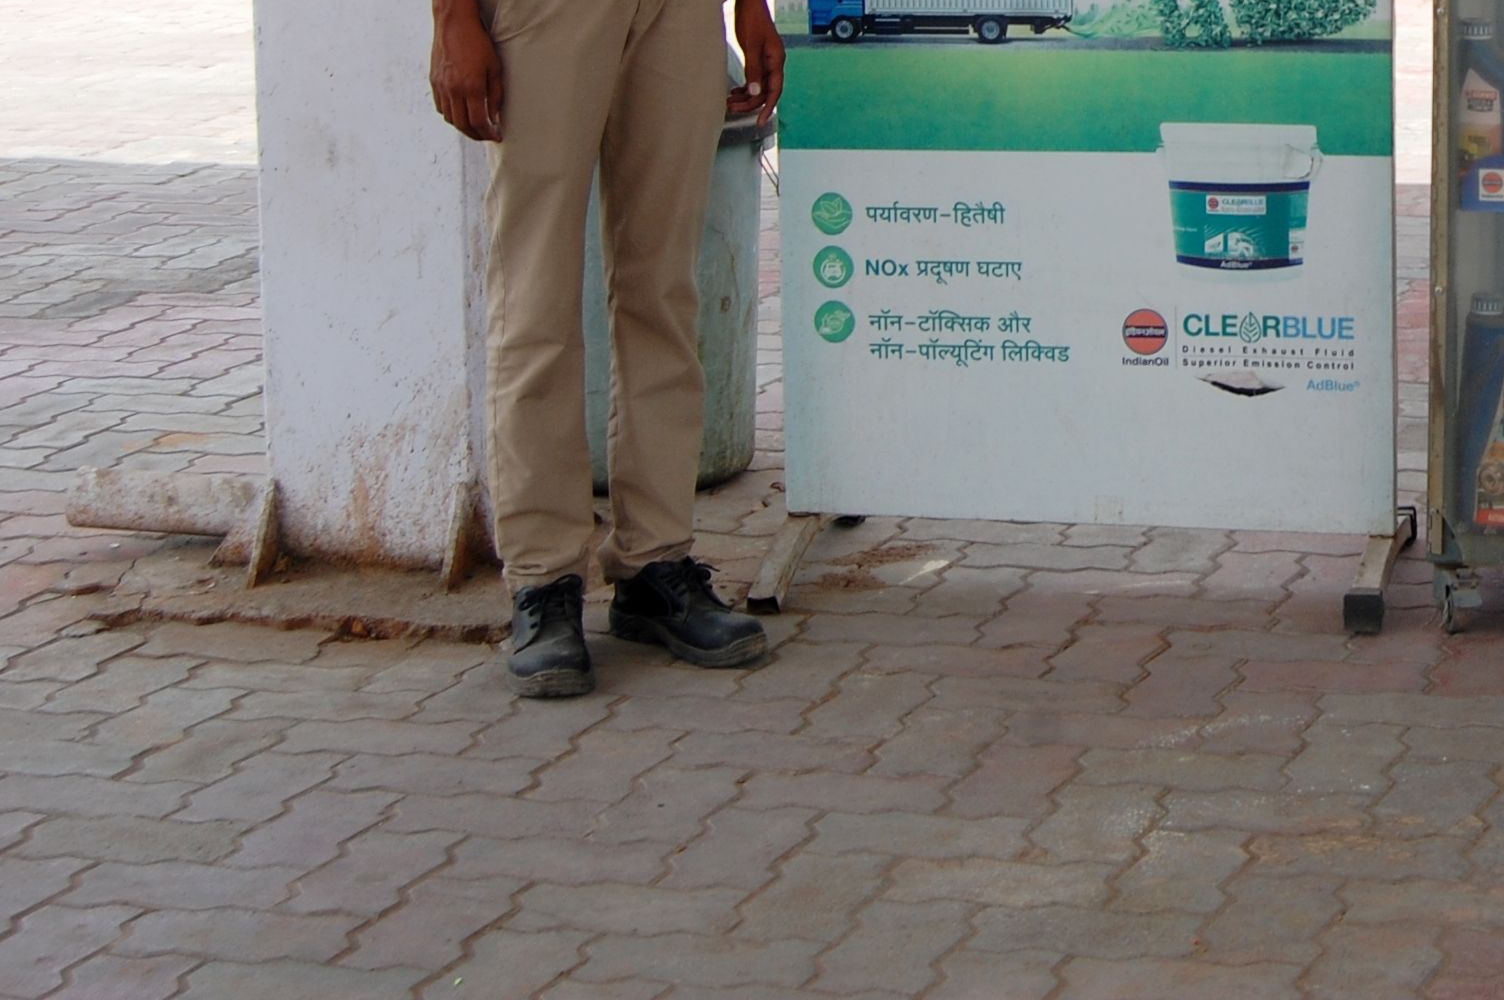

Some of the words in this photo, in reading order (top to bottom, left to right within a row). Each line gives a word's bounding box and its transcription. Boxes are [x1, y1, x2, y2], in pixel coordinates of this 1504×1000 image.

[865, 259, 909, 276] NOx
[916, 260, 970, 285] प्रदूषण
[977, 261, 1022, 281] घटाए
[868, 308, 990, 333] नॉन-टॉक्सिक
[998, 310, 1032, 333] और
[1002, 339, 1070, 362] लिक्विड
[1182, 345, 1232, 354] Diesel
[1242, 346, 1303, 356] Exhaust
[1314, 348, 1355, 357] Fluid
[1122, 357, 1169, 367] IndianOil
[1182, 358, 1237, 368] Superior
[1243, 358, 1301, 369] Emission
[1307, 361, 1355, 371] Control
